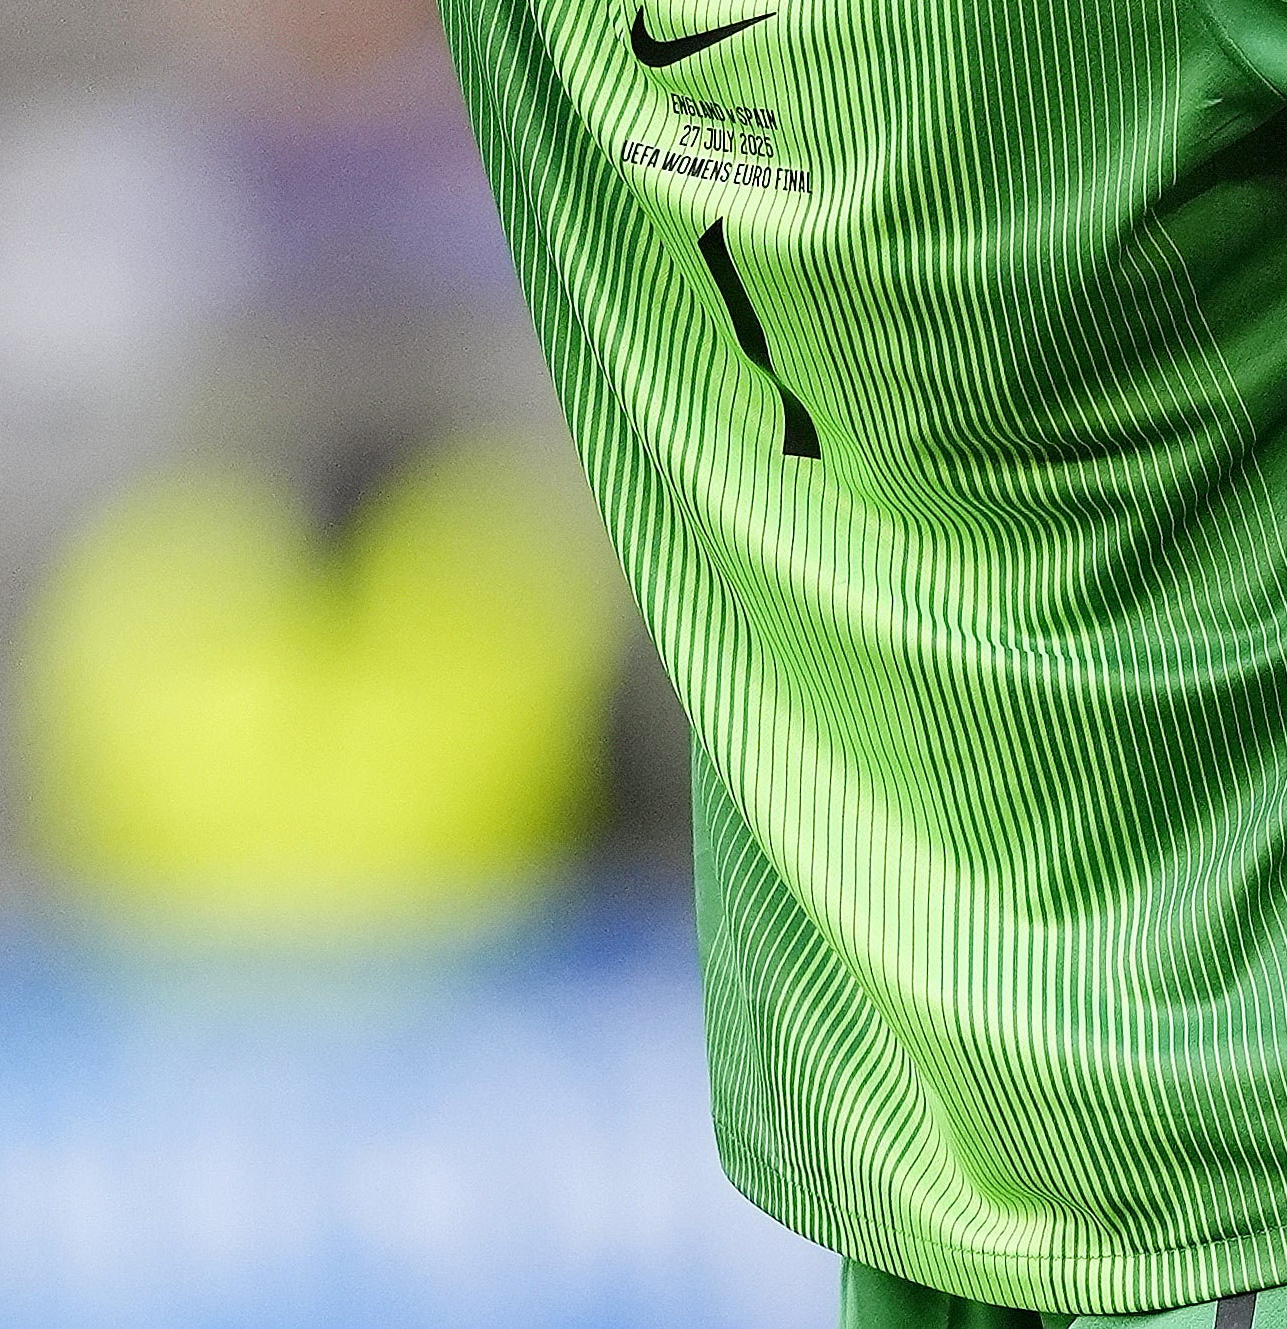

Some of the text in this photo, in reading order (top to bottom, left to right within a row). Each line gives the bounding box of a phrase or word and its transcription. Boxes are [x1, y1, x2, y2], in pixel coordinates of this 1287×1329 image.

[670, 92, 726, 122] ENGLAND
[735, 106, 778, 131] SPAIN
[679, 124, 774, 158] 27 JULY 2025
[621, 139, 813, 194] UEFA WOMENS EURO FINAL
[698, 216, 821, 460] 1
